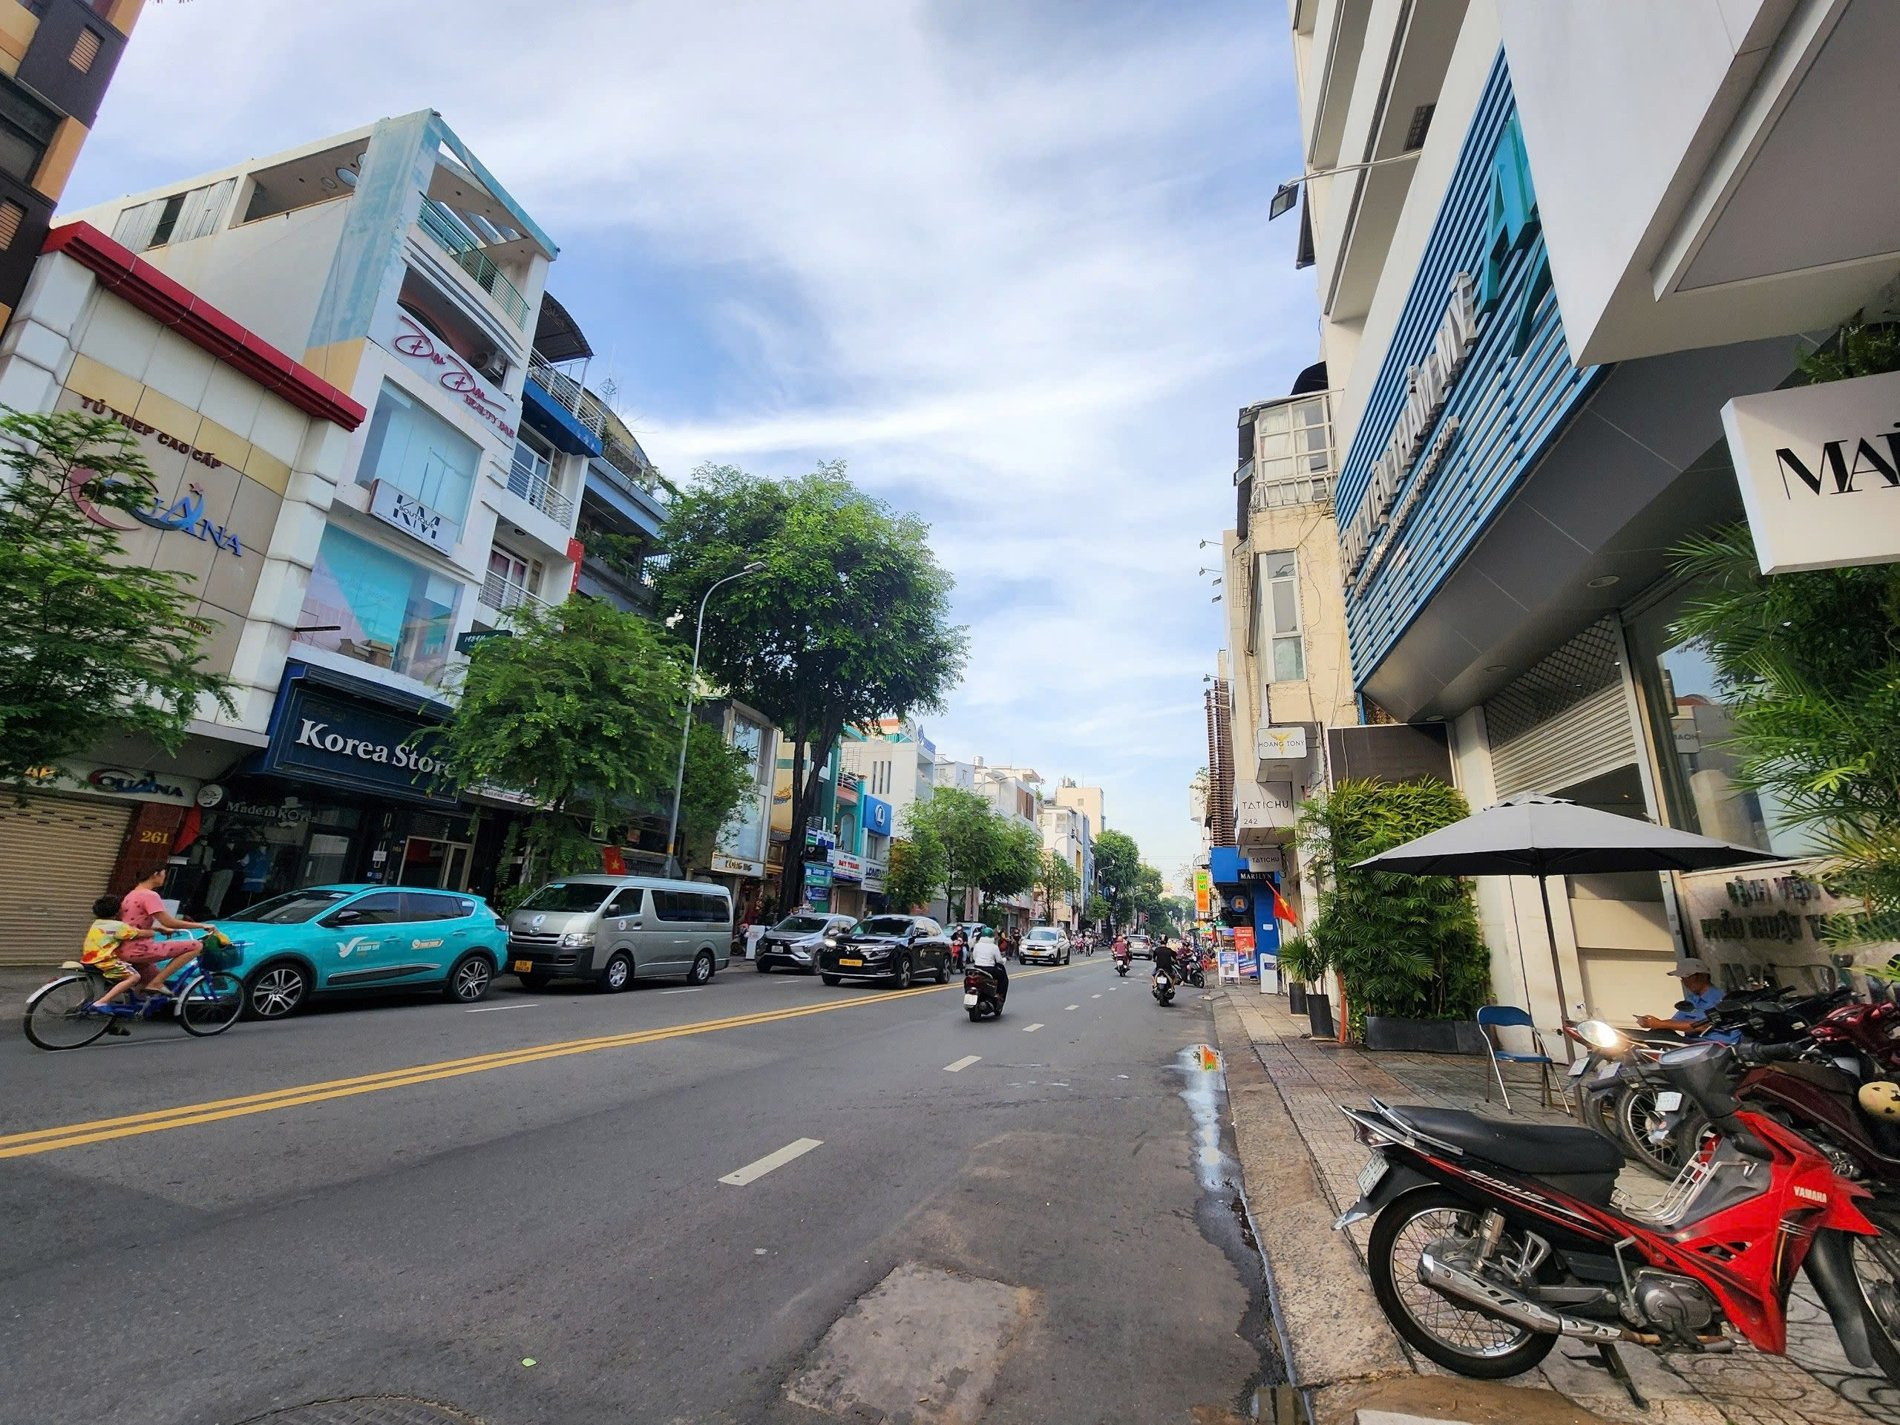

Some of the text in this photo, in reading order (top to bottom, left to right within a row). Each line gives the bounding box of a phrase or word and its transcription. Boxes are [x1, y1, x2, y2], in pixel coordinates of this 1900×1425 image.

[499, 417, 515, 439] BAR
[157, 432, 190, 454] CAO
[392, 494, 441, 540] KM
[398, 505, 435, 530] BOUTIQUE
[296, 717, 458, 779] Korea Store
[226, 801, 263, 815] Made
[1242, 801, 1289, 810] TATICHU
[139, 830, 170, 845] 261
[1240, 872, 1272, 880] MARILYN
[1793, 1185, 1827, 1203] YAMAHA
